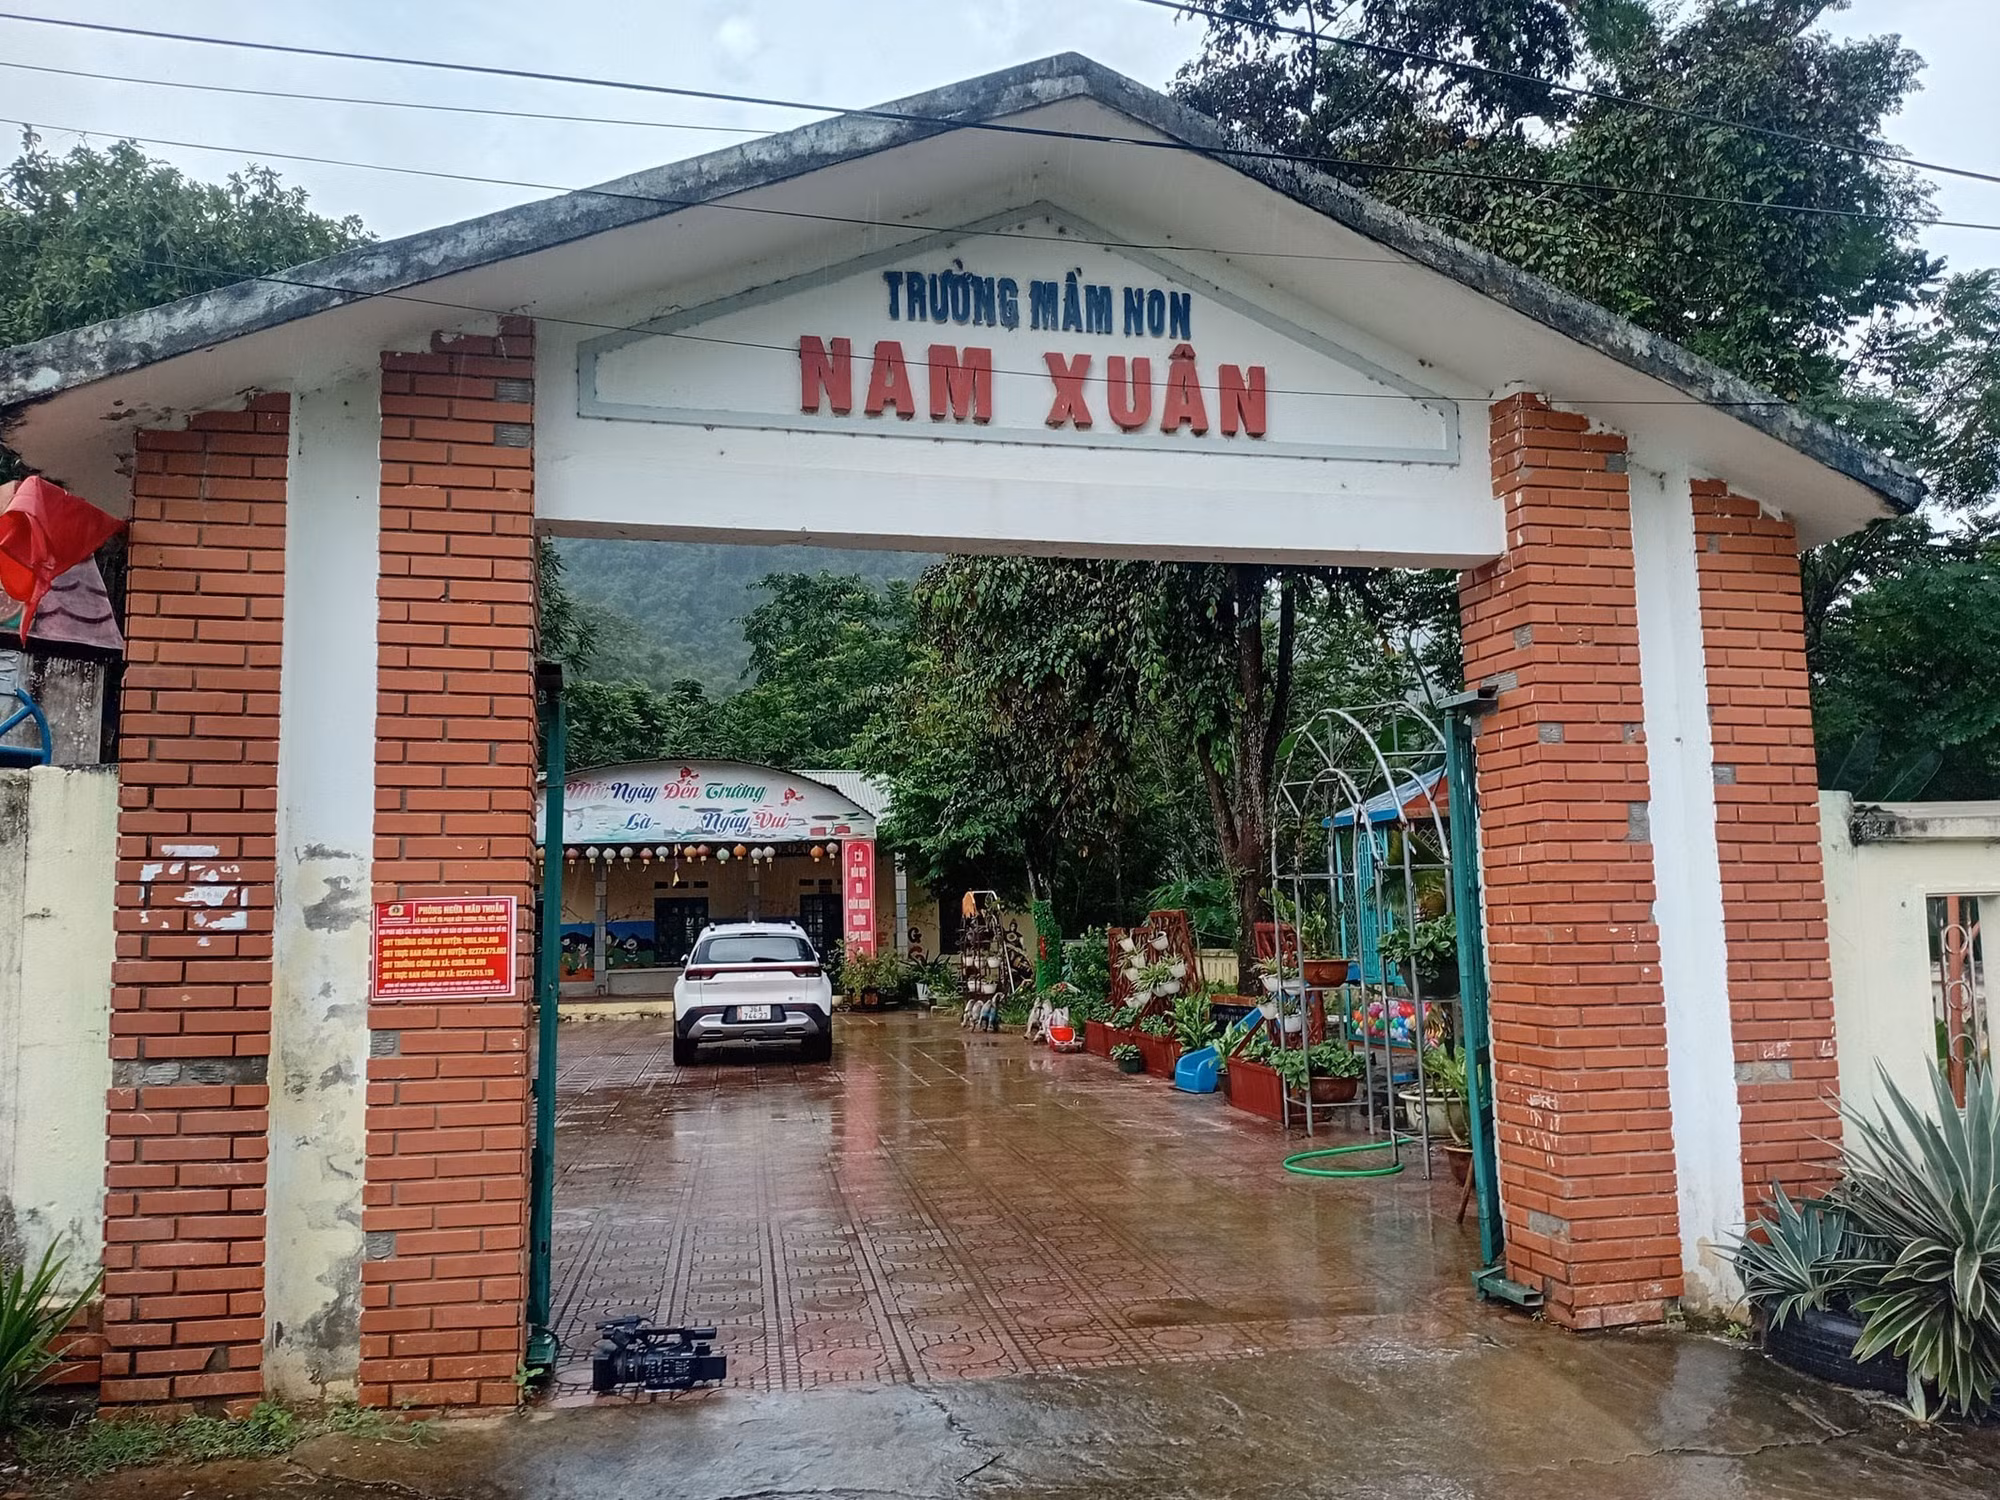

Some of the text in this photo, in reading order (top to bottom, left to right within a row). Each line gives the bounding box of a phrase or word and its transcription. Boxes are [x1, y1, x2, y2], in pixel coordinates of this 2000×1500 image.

[884, 258, 1192, 340] TRƯỜNG MẦM NON
[800, 336, 1266, 438] NAM XUÂN
[611, 782, 657, 802] Ngày
[663, 780, 700, 799] Đến
[705, 782, 766, 803] Trường
[625, 813, 652, 830] Là
[702, 813, 750, 833] Ngày
[755, 813, 789, 829] Vui
